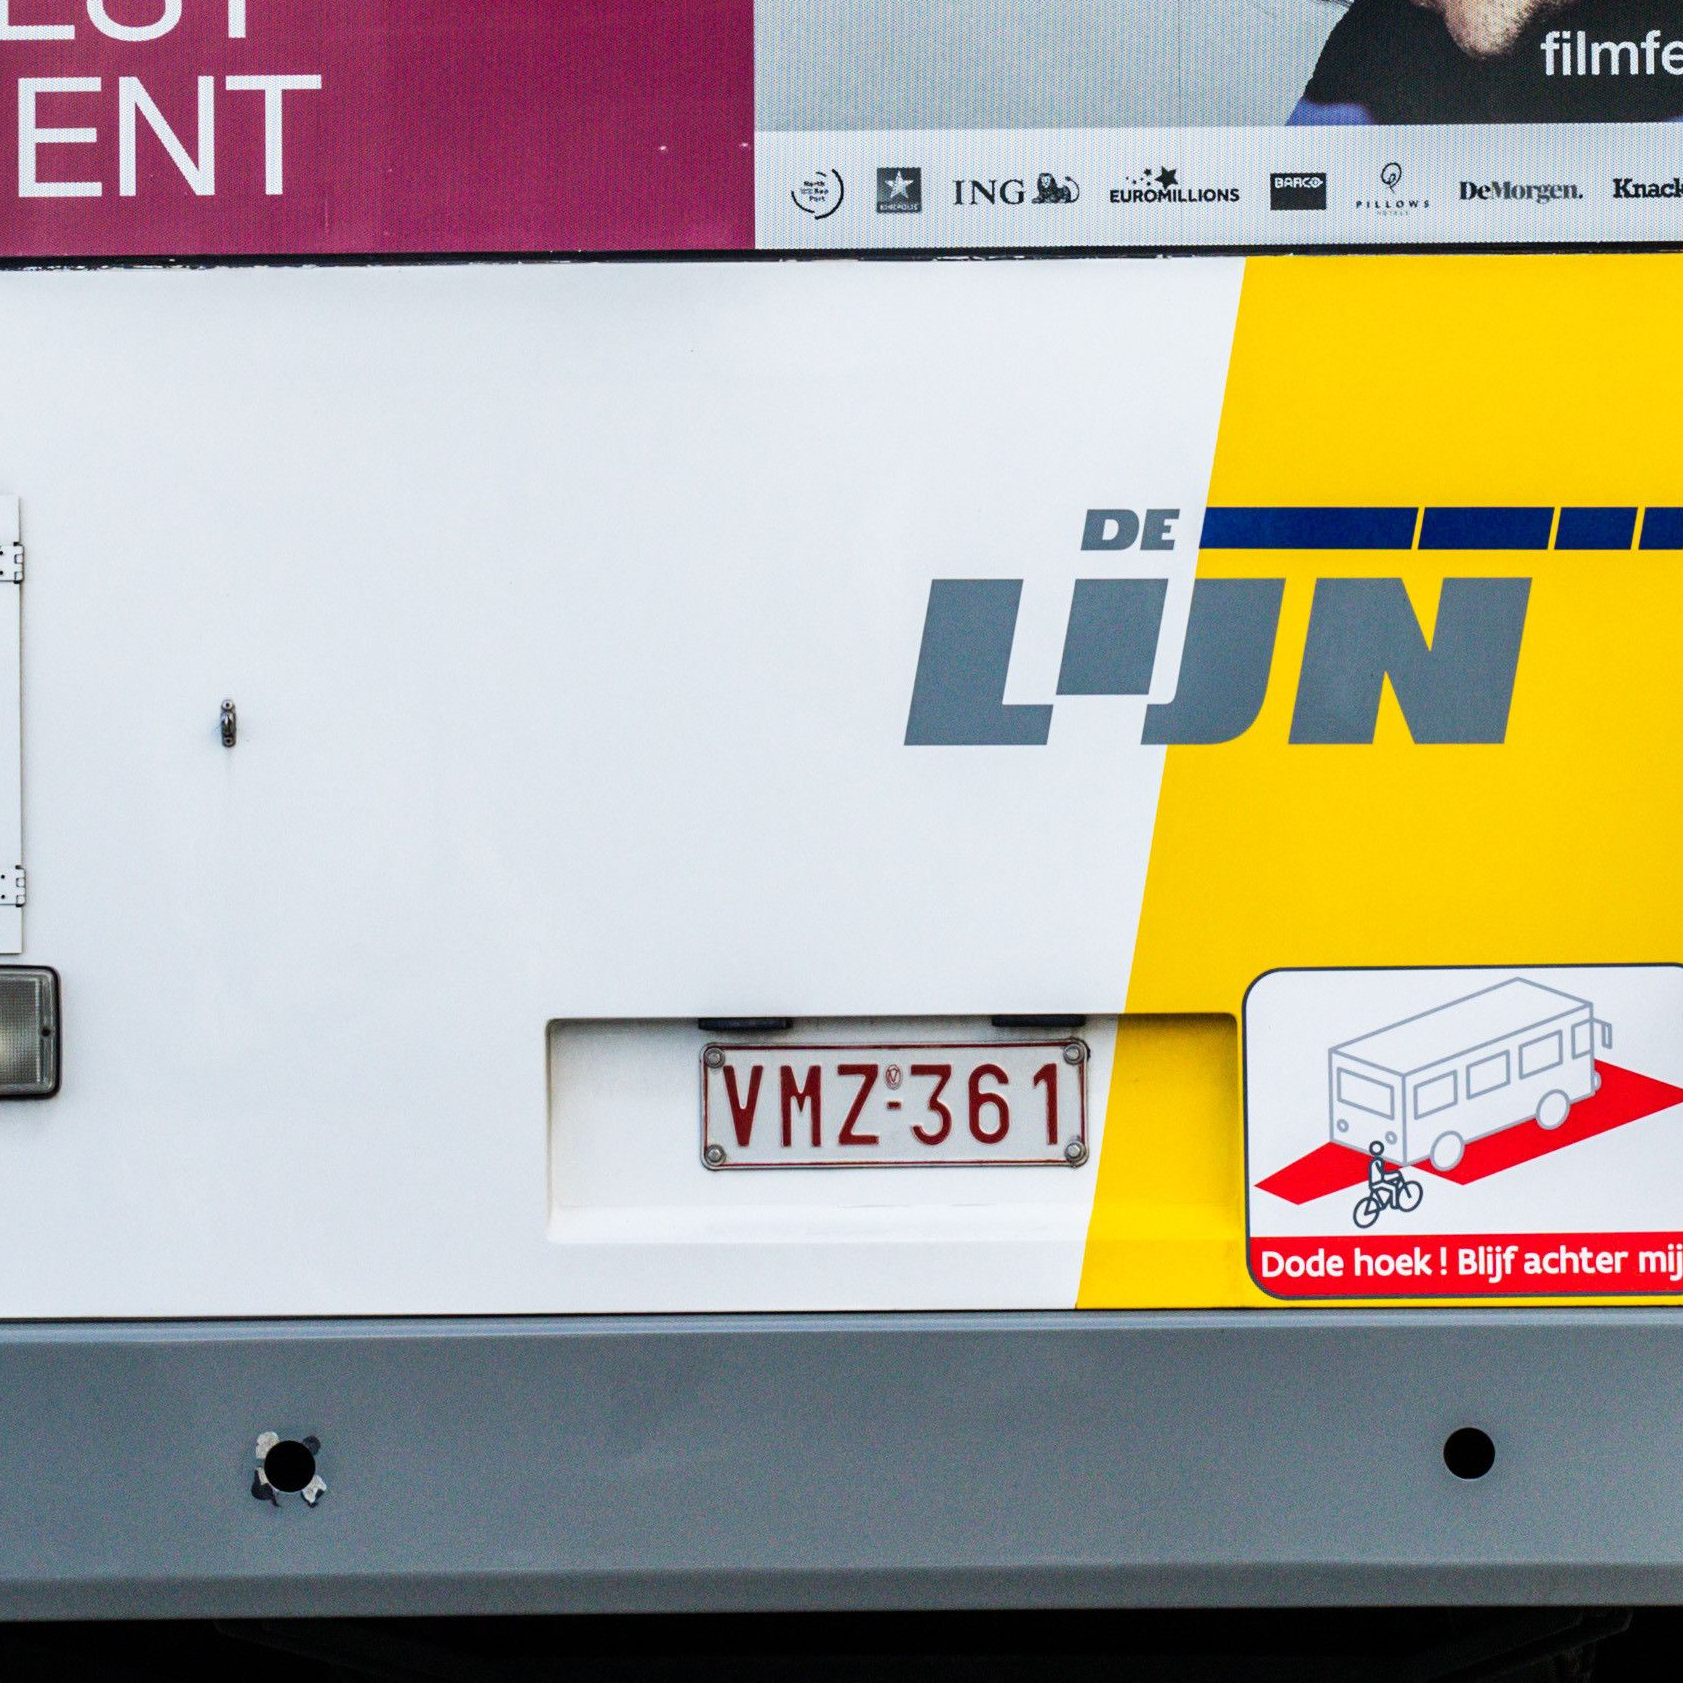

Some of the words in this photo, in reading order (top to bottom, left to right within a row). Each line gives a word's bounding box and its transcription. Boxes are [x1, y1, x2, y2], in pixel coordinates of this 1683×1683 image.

[953, 179, 1027, 205] ING
[1274, 177, 1323, 188] BARCO
[1459, 181, 1583, 204] DeMorgen.
[1110, 188, 1240, 204] EUROMILLIONS
[1355, 200, 1430, 209] PILLOWS
[1081, 509, 1180, 552] DE
[904, 577, 1532, 745] LIJN
[723, 1064, 1058, 1147] VMZ-361
[1261, 1248, 1344, 1278] Dode
[1354, 1247, 1432, 1277] hoek
[1459, 1245, 1519, 1283] Blijf
[1523, 1243, 1628, 1275] achter
[1639, 1243, 1683, 1281] mij
